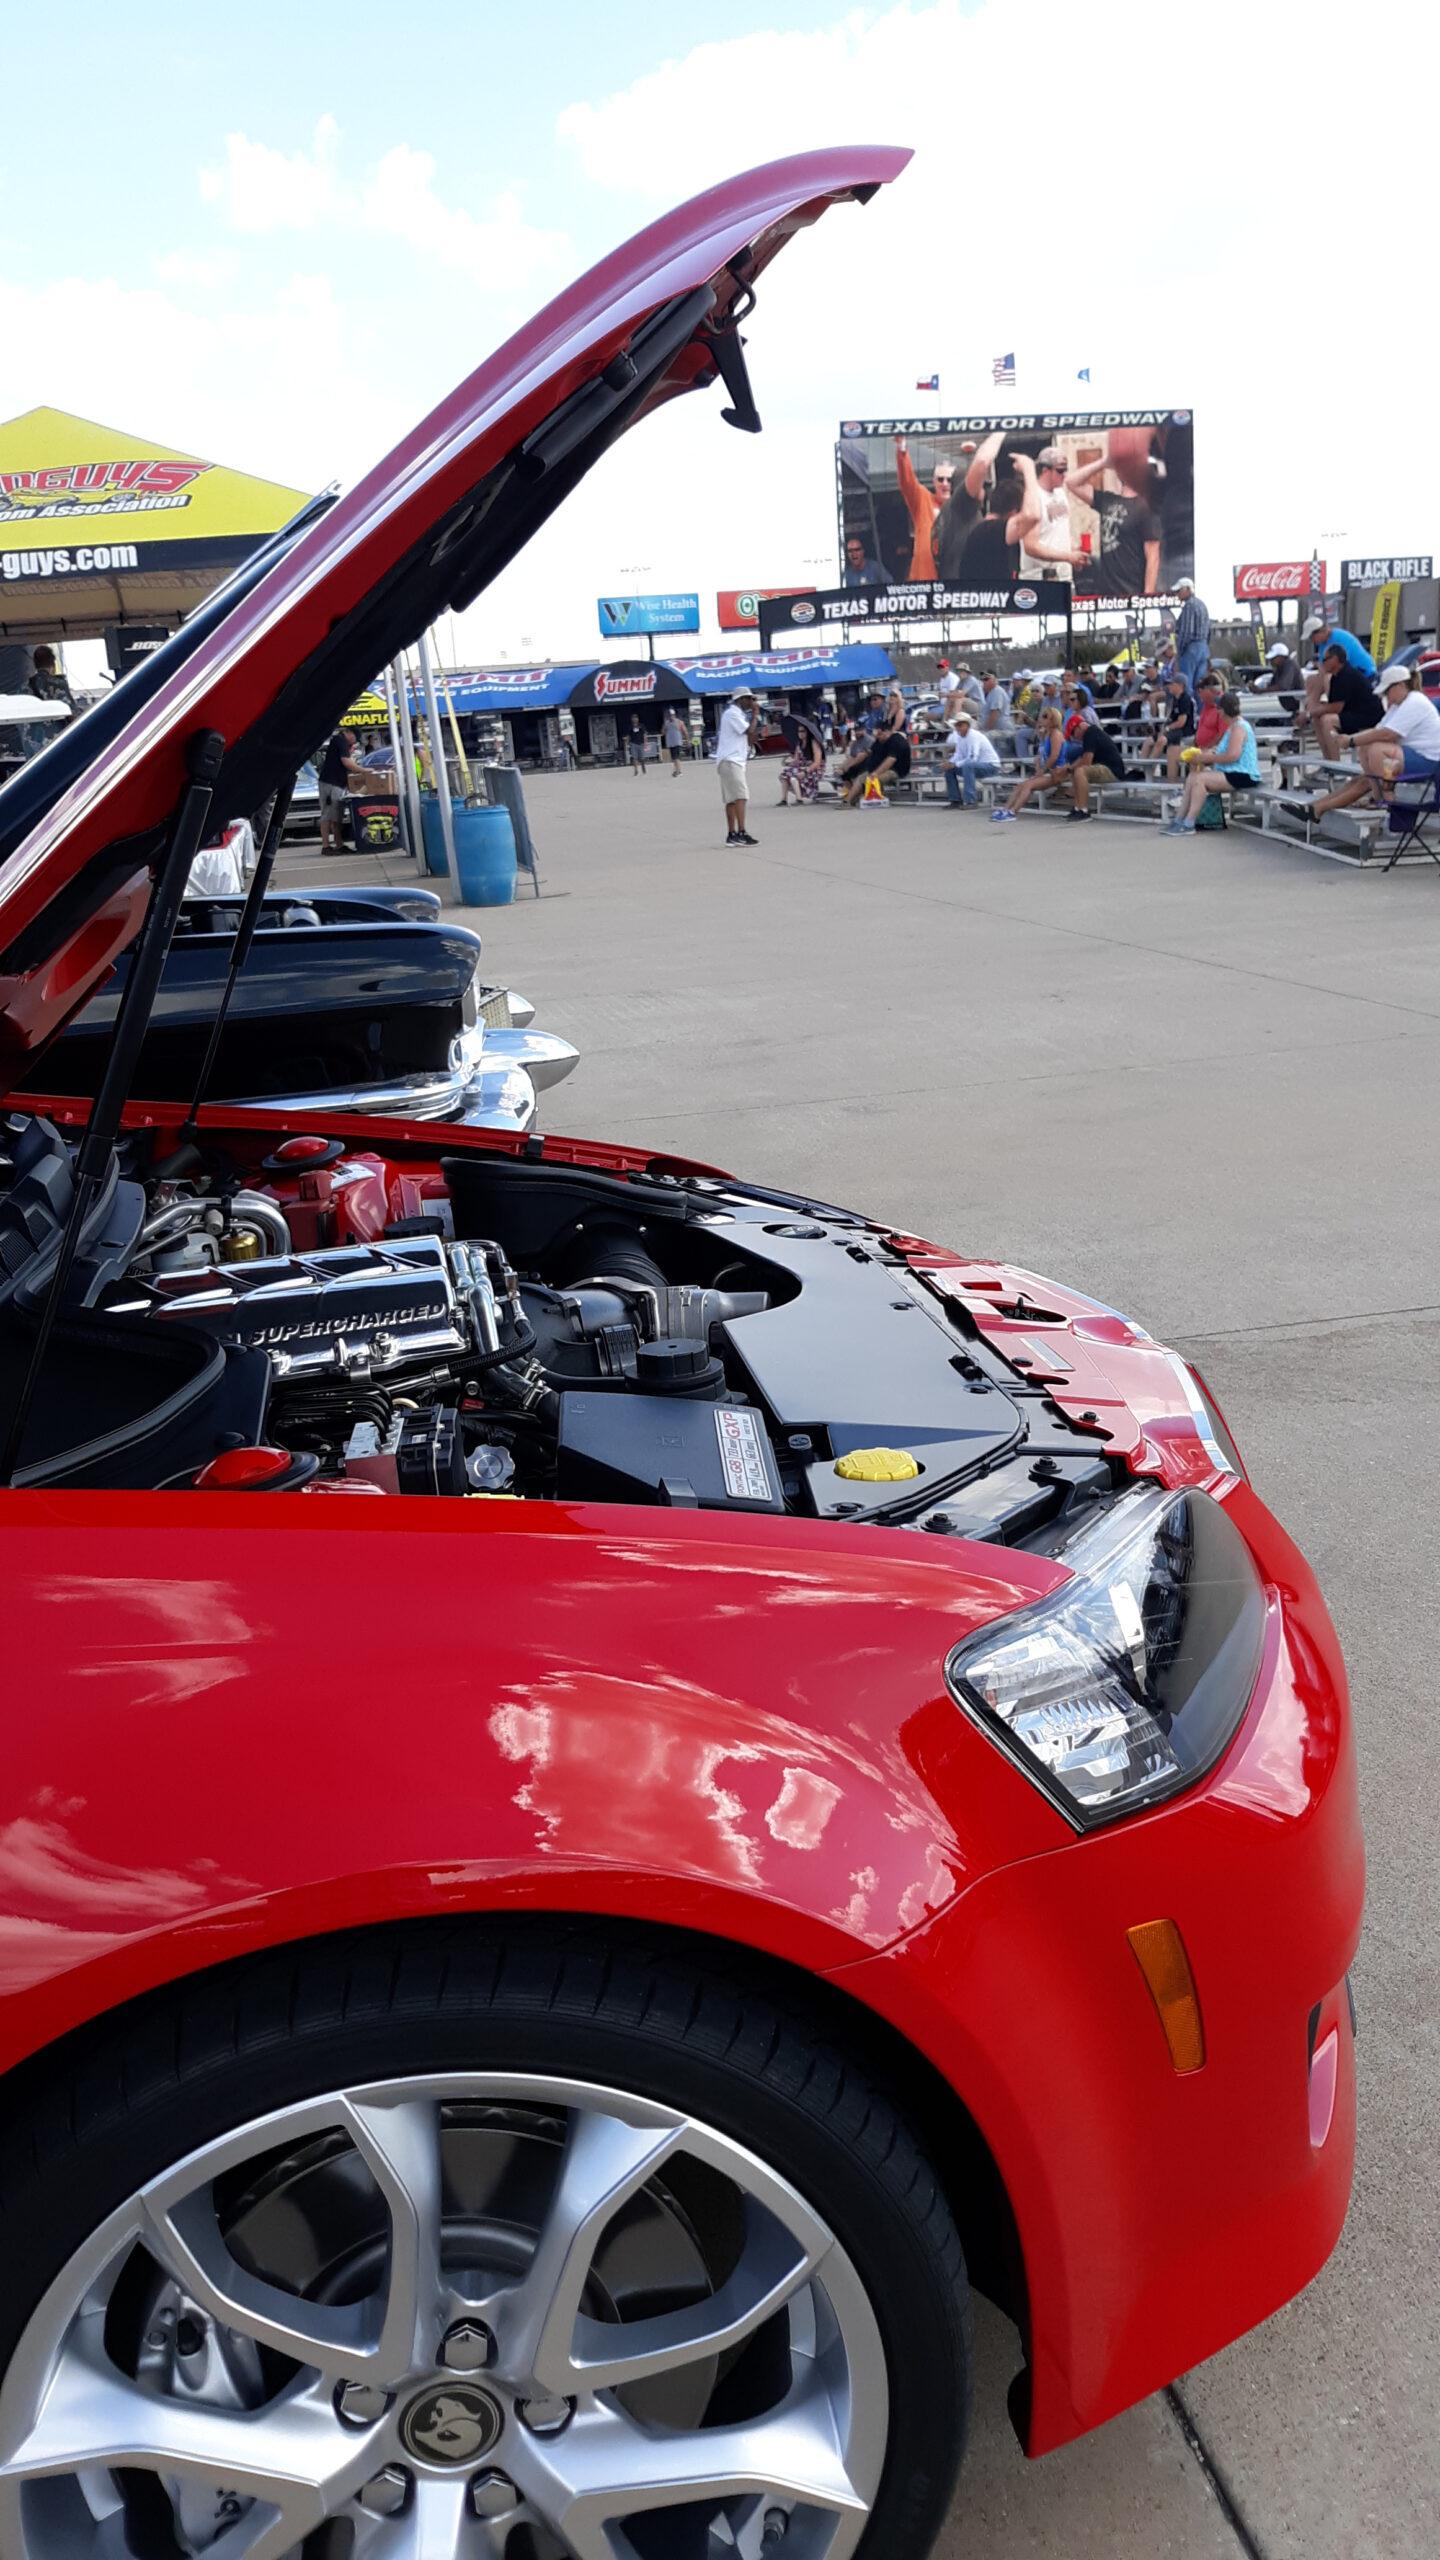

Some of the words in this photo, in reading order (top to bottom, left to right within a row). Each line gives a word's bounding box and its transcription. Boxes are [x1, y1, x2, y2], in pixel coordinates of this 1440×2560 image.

[863, 420, 941, 435] TEXAS
[946, 416, 1036, 432] MOTOR
[1042, 411, 1169, 429] SPEEDWAY
[38, 494, 189, 518] Association
[0, 545, 139, 580] guys.com
[1348, 561, 1390, 580] BLACK
[1393, 558, 1430, 578] RIFLE
[886, 583, 931, 595] Welcome
[933, 582, 945, 592] to
[662, 597, 697, 610] Health
[822, 599, 869, 619] TEXAS
[874, 593, 928, 614] MOTOR
[932, 591, 1010, 610] SPEEDWAY
[1071, 600, 1096, 611] exas
[1097, 597, 1129, 609] Motor
[649, 613, 685, 626] System
[695, 667, 751, 678] RACING
[754, 660, 841, 674] EQUIPMENT
[461, 683, 550, 696] EQUIPMENT
[252, 1303, 446, 1346] SUPERCHARGED
[722, 1412, 741, 1439] GXP
[729, 1459, 743, 1474] G8
